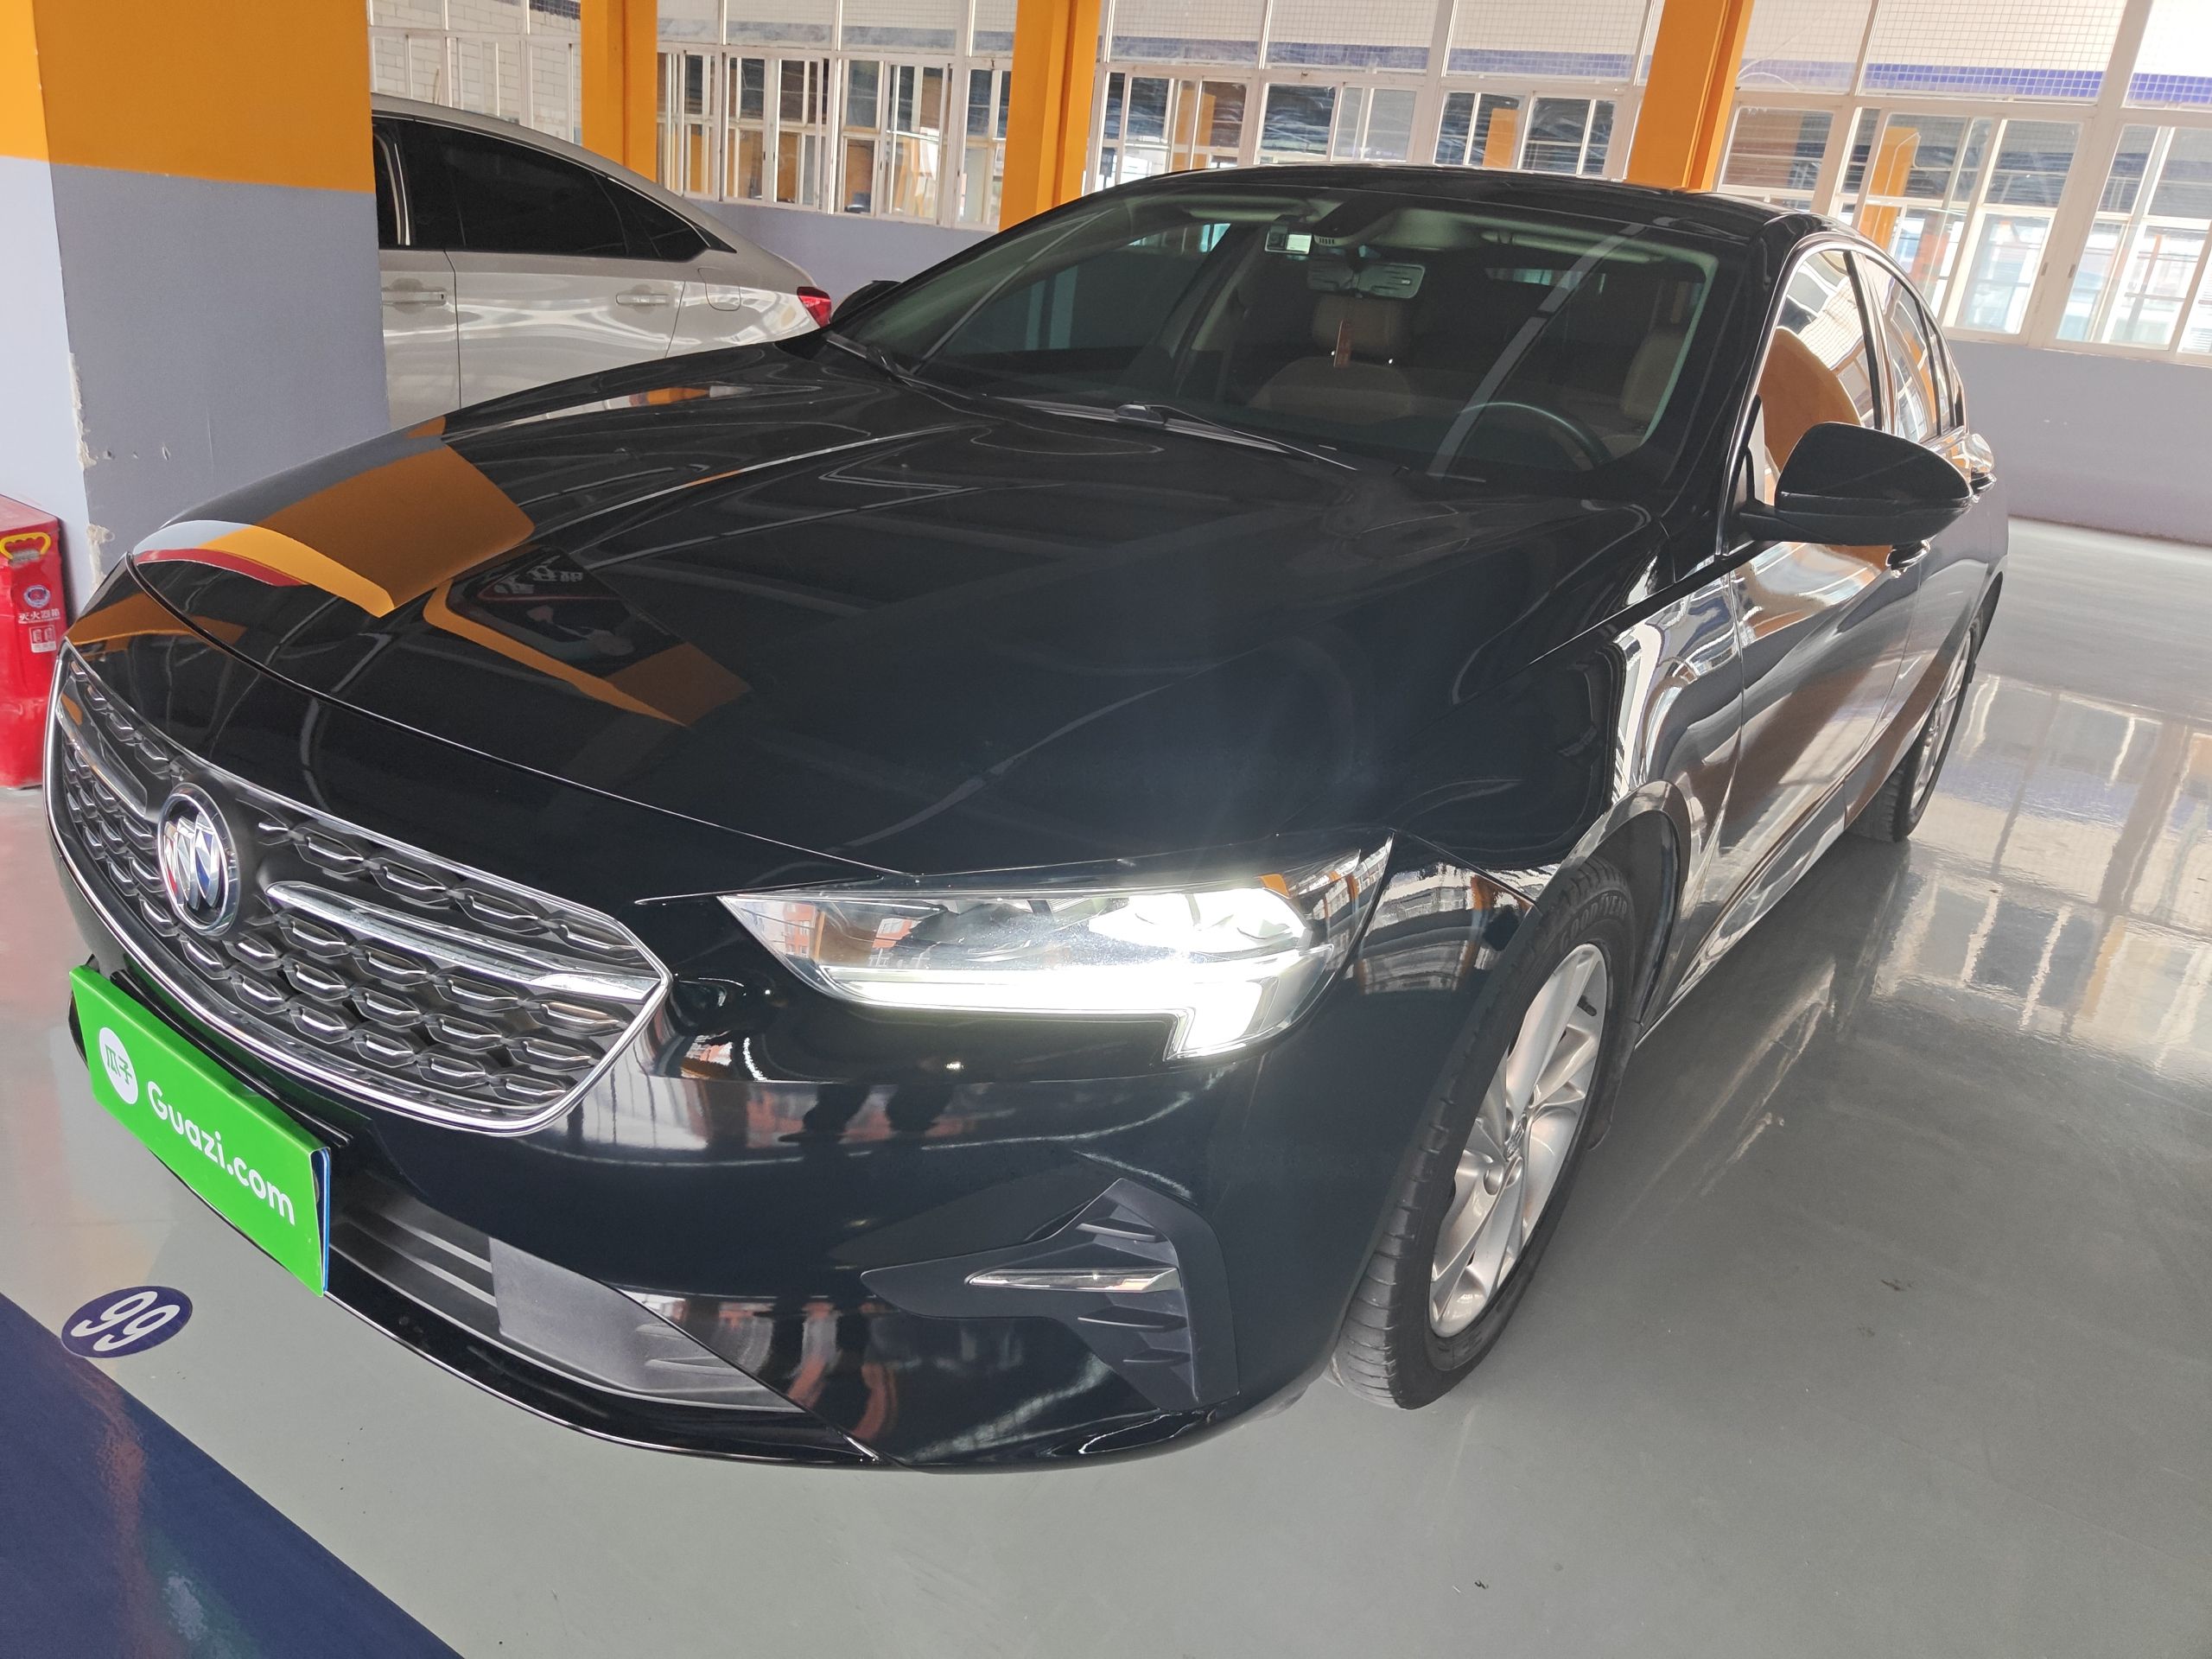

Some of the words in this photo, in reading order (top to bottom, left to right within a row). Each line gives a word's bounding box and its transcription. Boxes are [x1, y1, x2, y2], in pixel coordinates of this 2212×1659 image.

[105, 1043, 133, 1086] 瓜子
[147, 1080, 296, 1225] Guazi.com
[71, 1291, 180, 1351] 99
